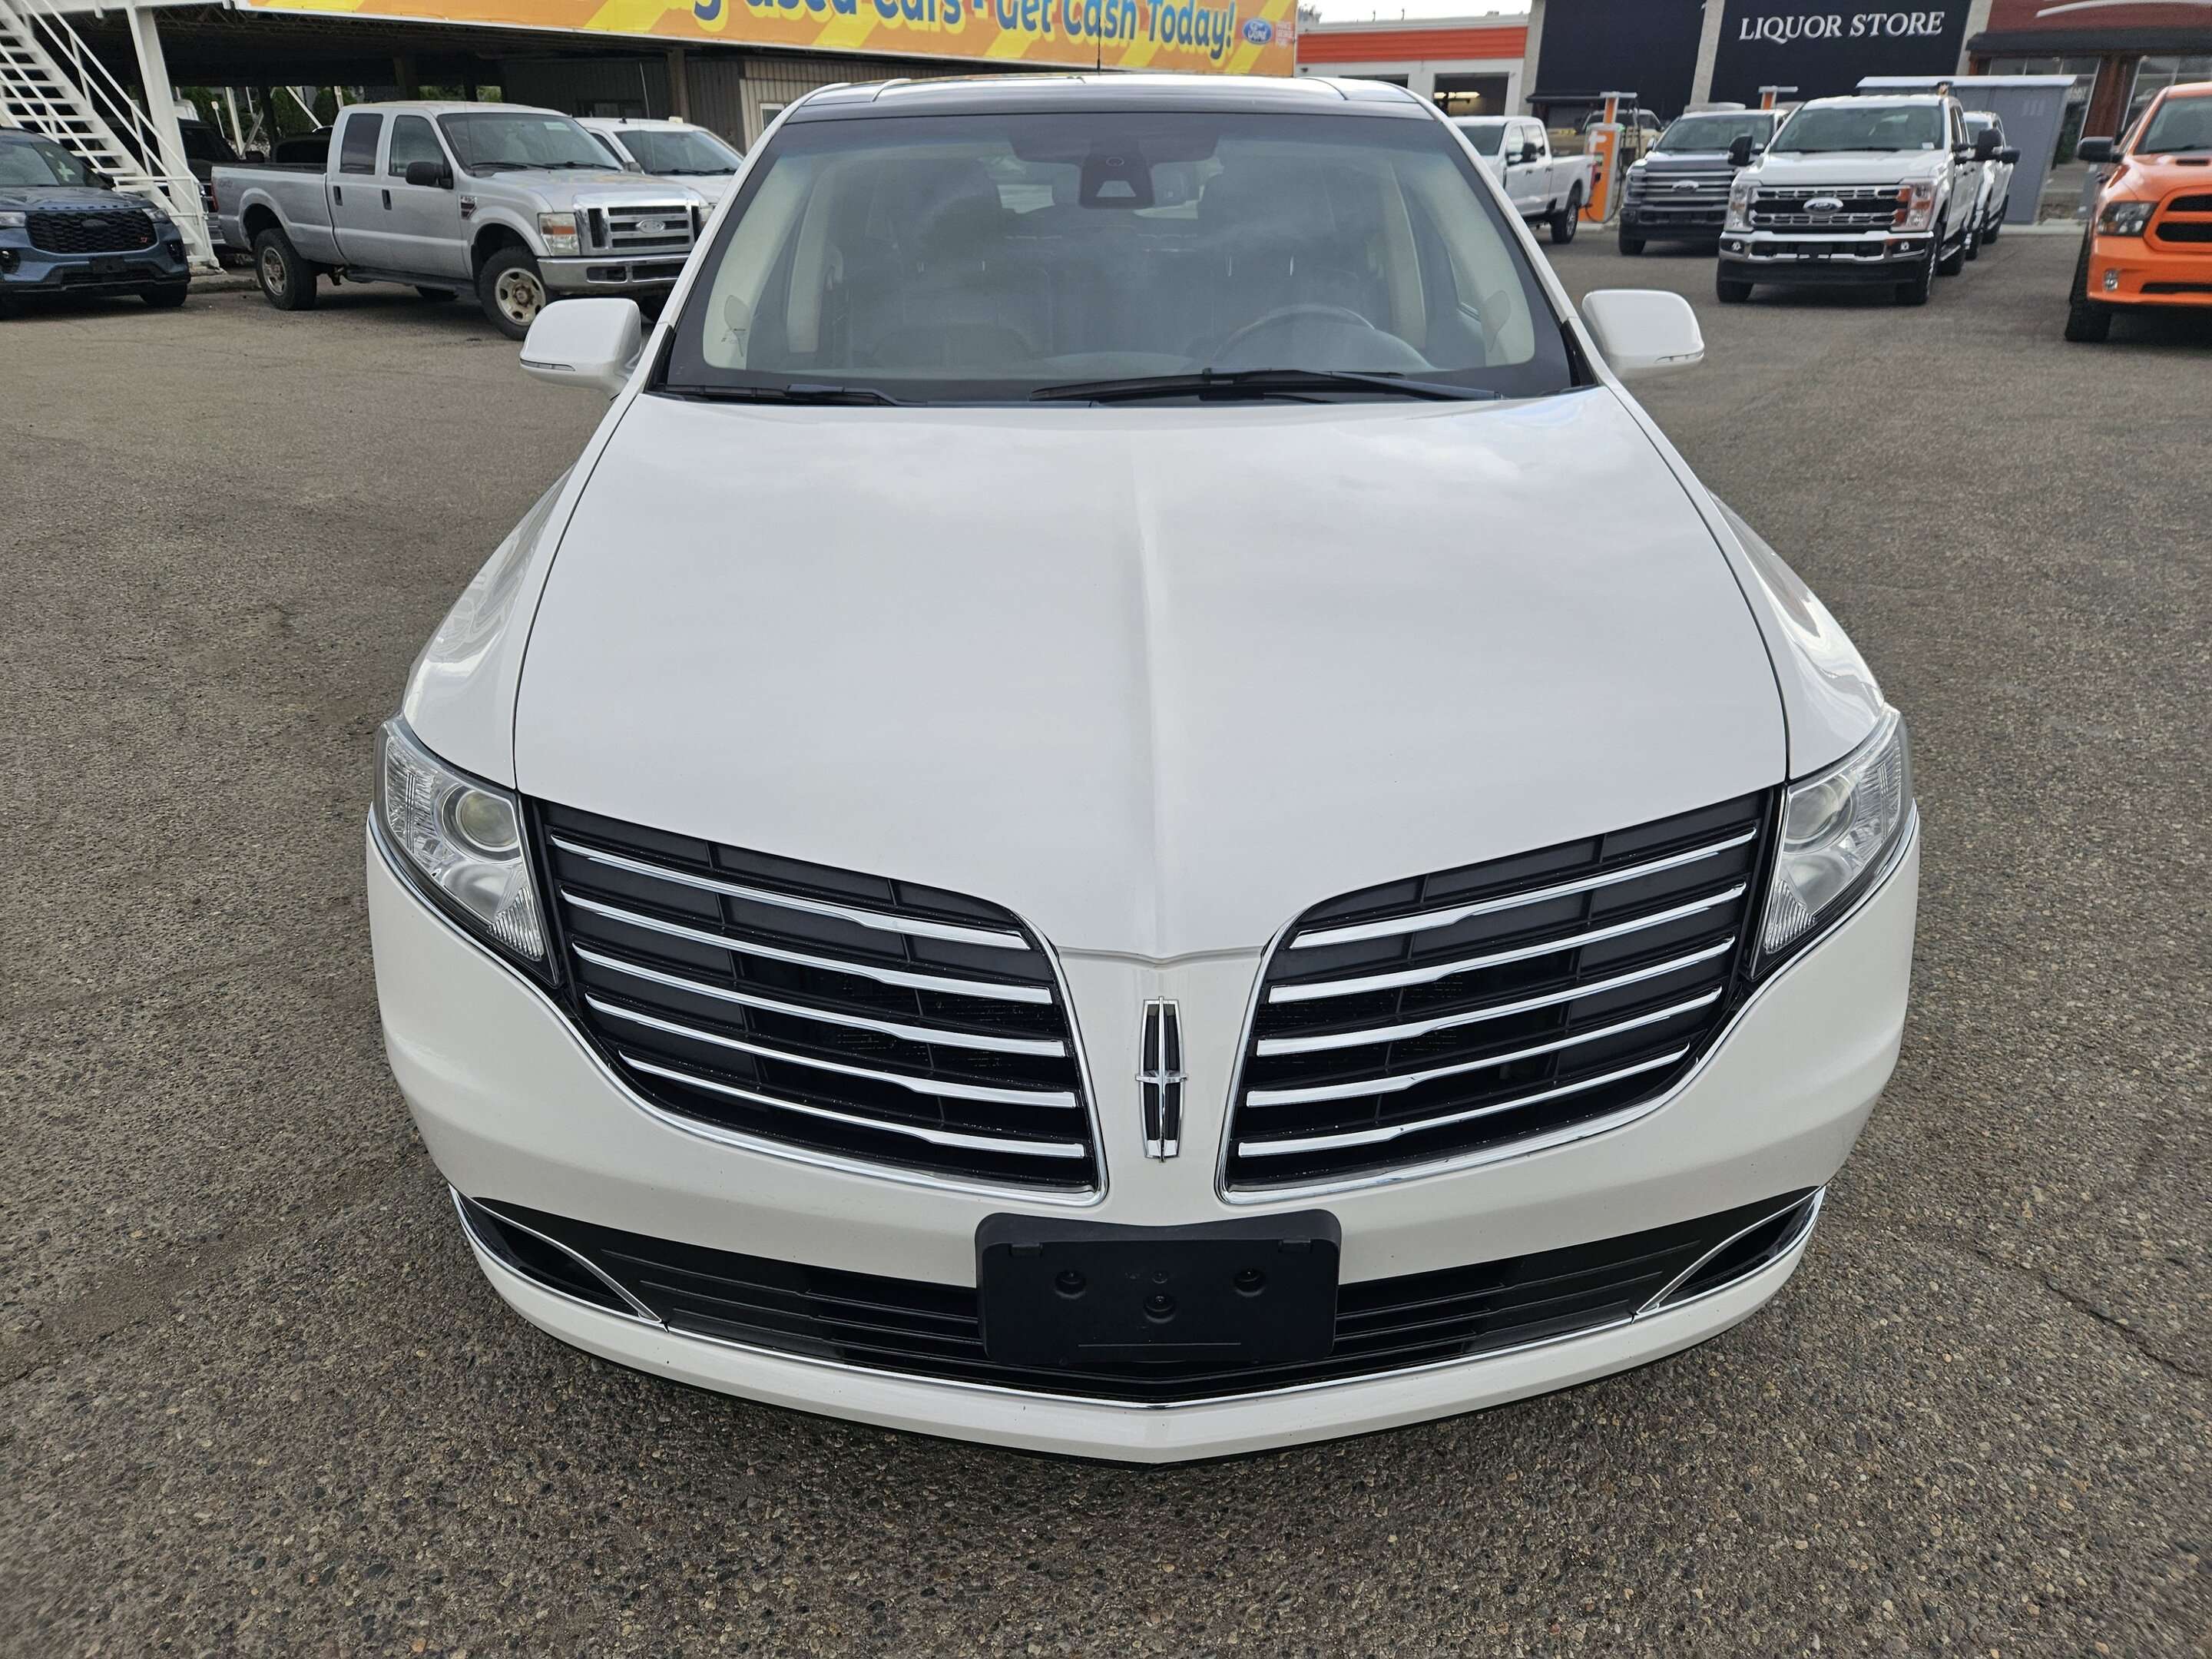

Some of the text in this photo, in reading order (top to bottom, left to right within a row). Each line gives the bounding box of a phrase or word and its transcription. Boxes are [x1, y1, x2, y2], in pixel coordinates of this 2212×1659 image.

[1063, 0, 1137, 40] Cash
[1147, 0, 1235, 60] Today!
[1739, 12, 1945, 45] LIQUOR STORE
